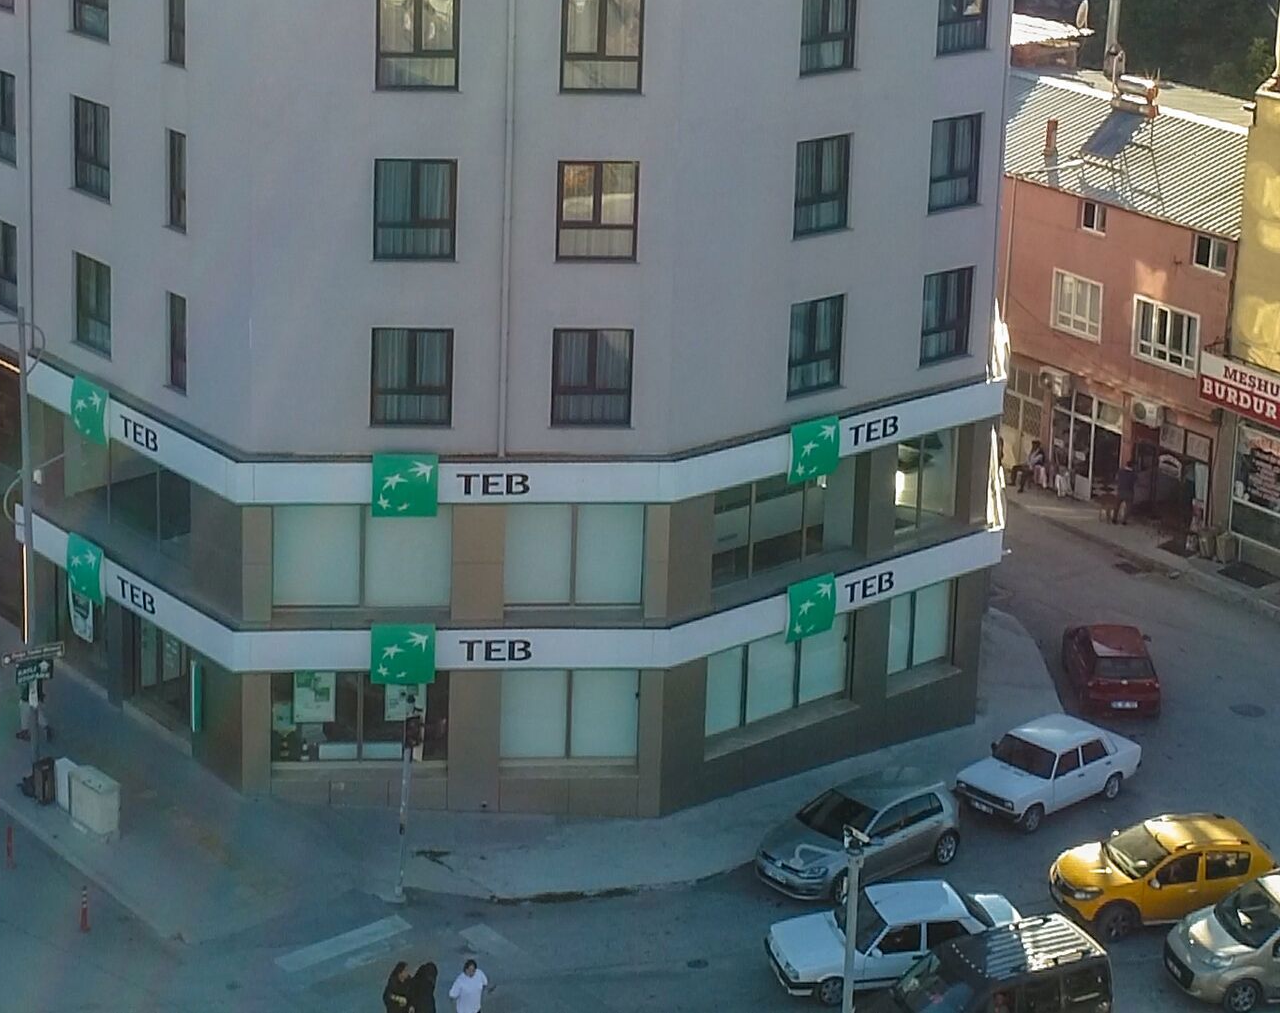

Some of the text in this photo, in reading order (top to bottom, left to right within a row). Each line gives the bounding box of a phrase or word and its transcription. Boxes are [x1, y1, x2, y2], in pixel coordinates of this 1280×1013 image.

[1202, 376, 1277, 420] BURDUR
[120, 414, 158, 452] TEB
[849, 415, 899, 446] TEB
[456, 473, 531, 496] TEB
[117, 575, 156, 615] TEB
[845, 570, 895, 603] TEB
[458, 639, 532, 662] TEB
